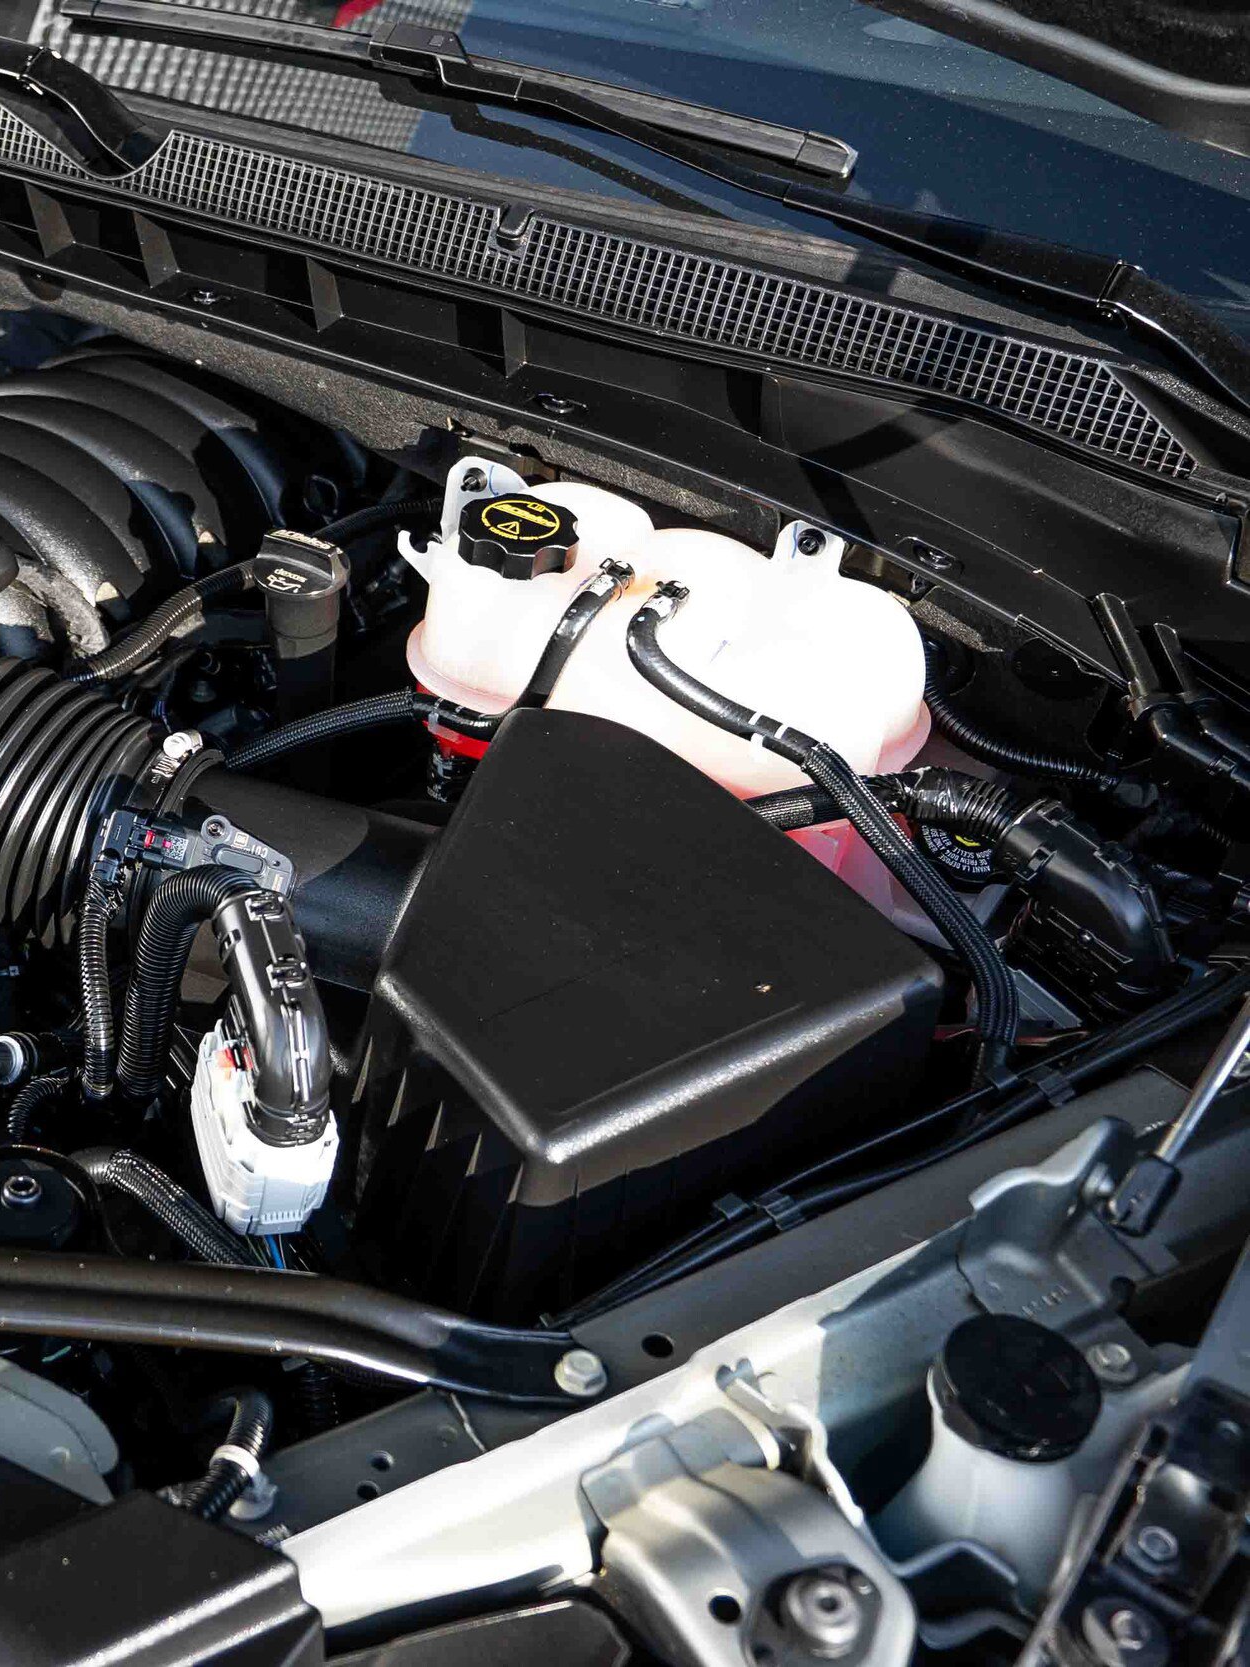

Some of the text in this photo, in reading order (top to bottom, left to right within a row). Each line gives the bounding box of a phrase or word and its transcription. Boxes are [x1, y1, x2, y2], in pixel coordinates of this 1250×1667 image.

[274, 568, 307, 583] dexos
[952, 846, 975, 859] SCELLE
[938, 852, 960, 869] DEPOSE
[960, 857, 978, 866] FREIN
[972, 865, 991, 873] AVANT
